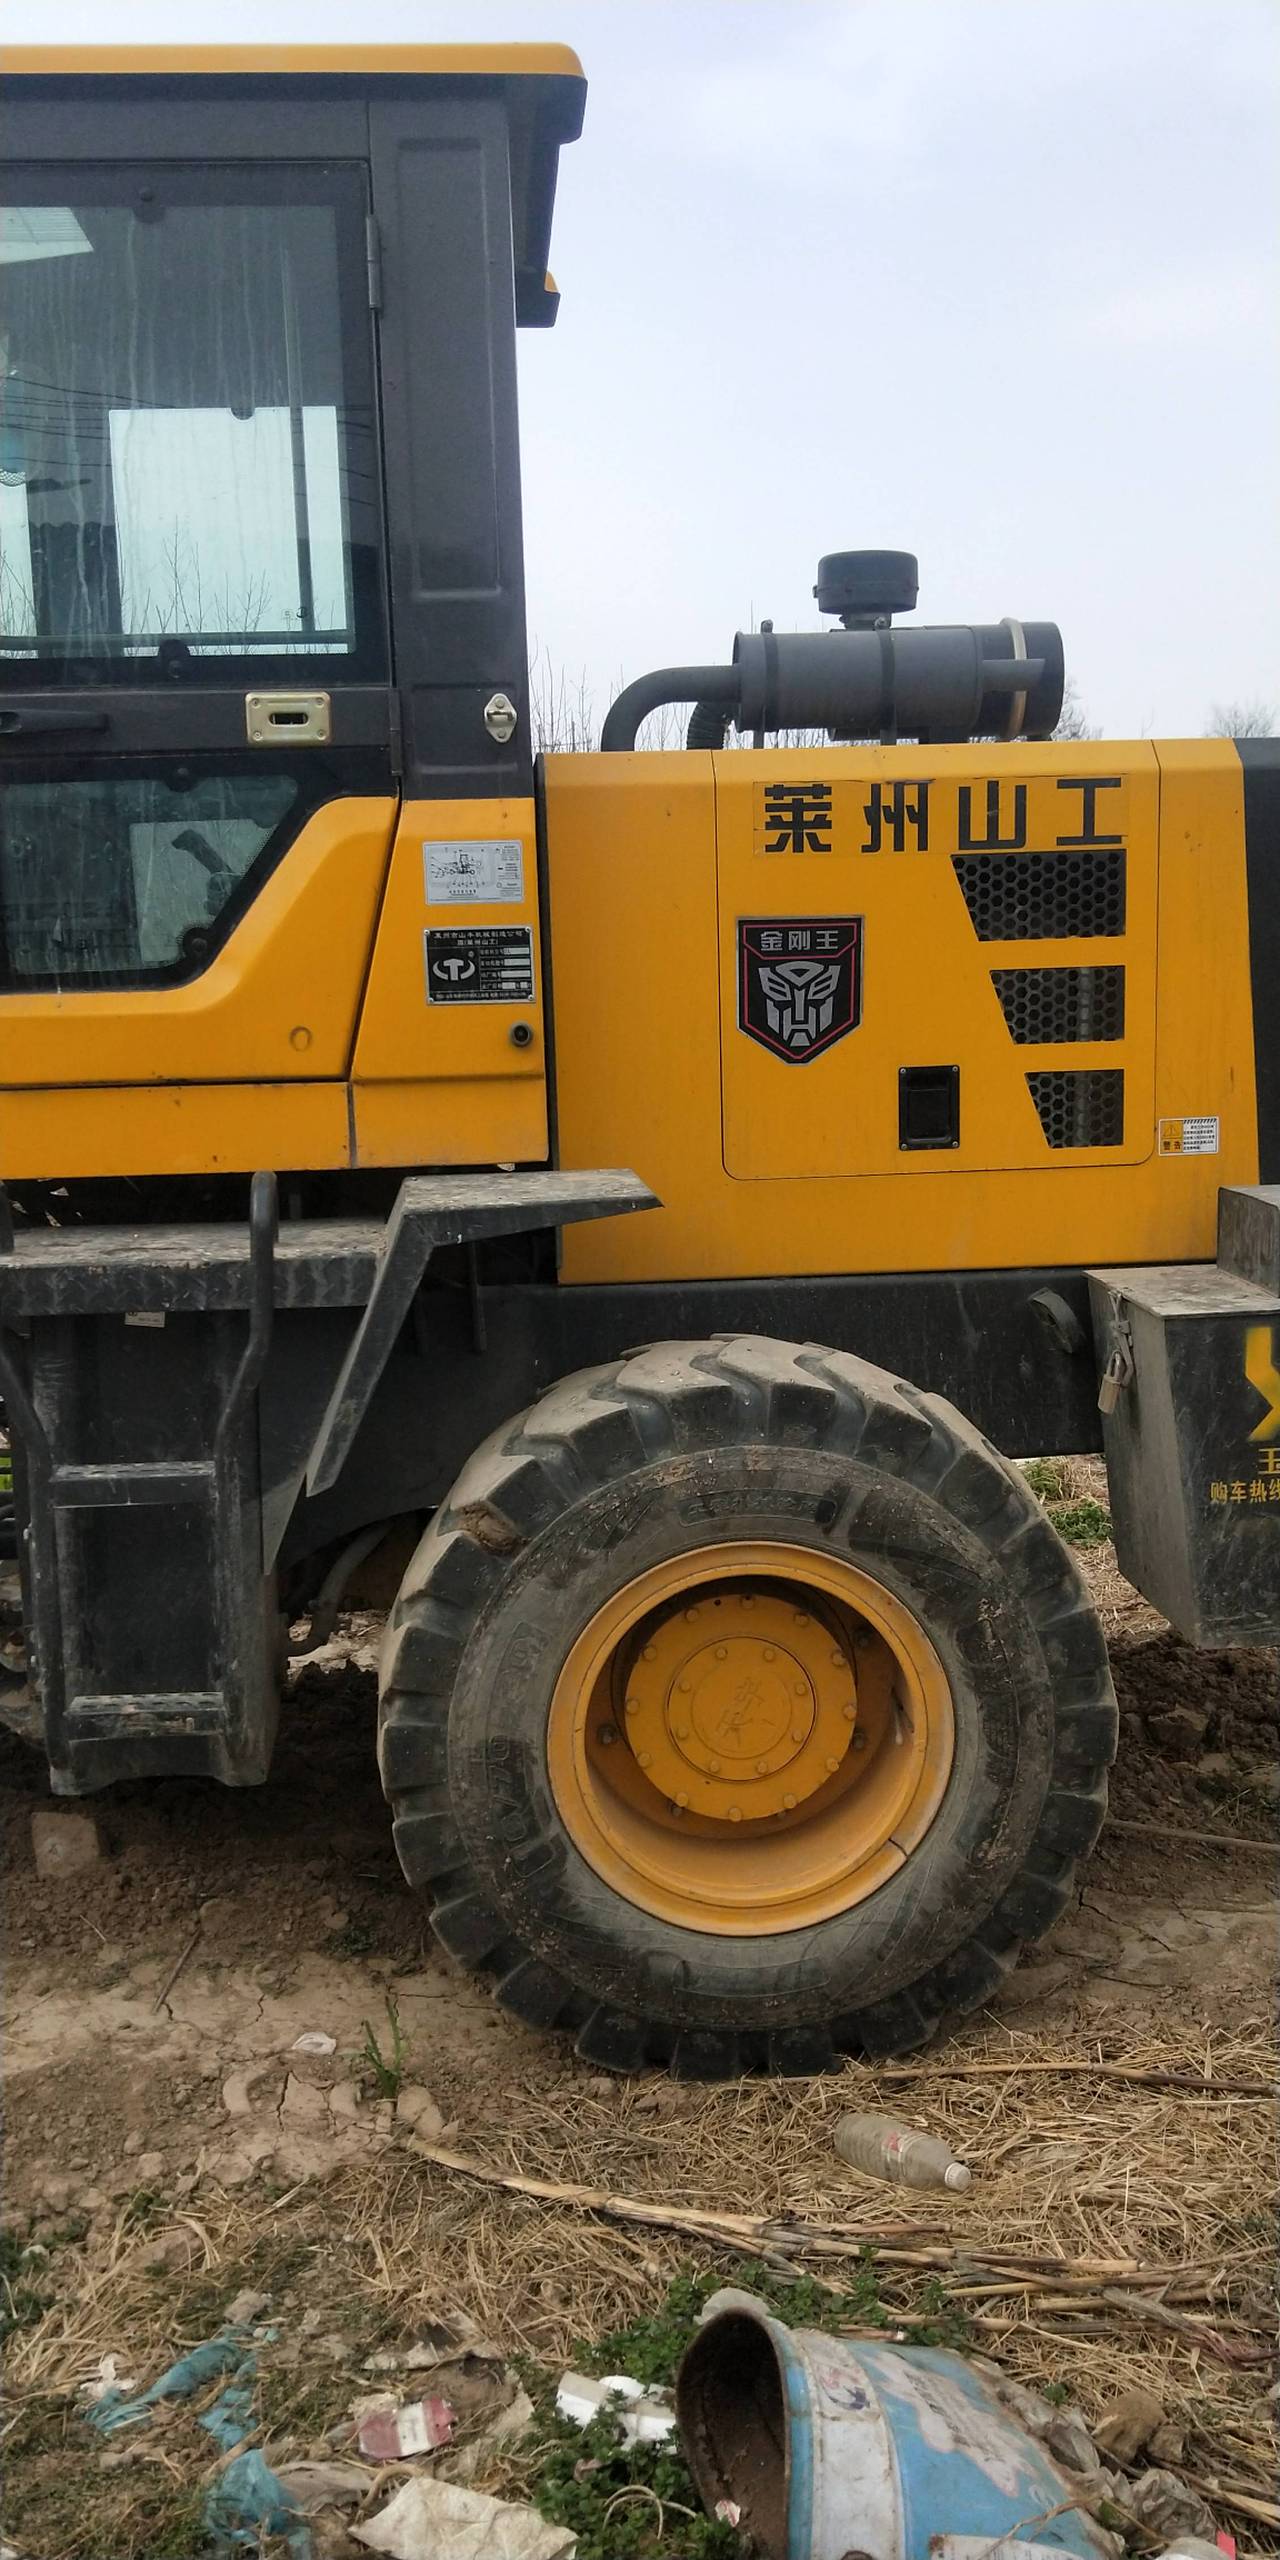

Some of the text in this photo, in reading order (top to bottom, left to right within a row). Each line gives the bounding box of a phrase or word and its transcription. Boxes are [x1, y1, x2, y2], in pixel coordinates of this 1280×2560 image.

[764, 777, 1122, 853] 莱州山工
[760, 930, 839, 951] 金刚王
